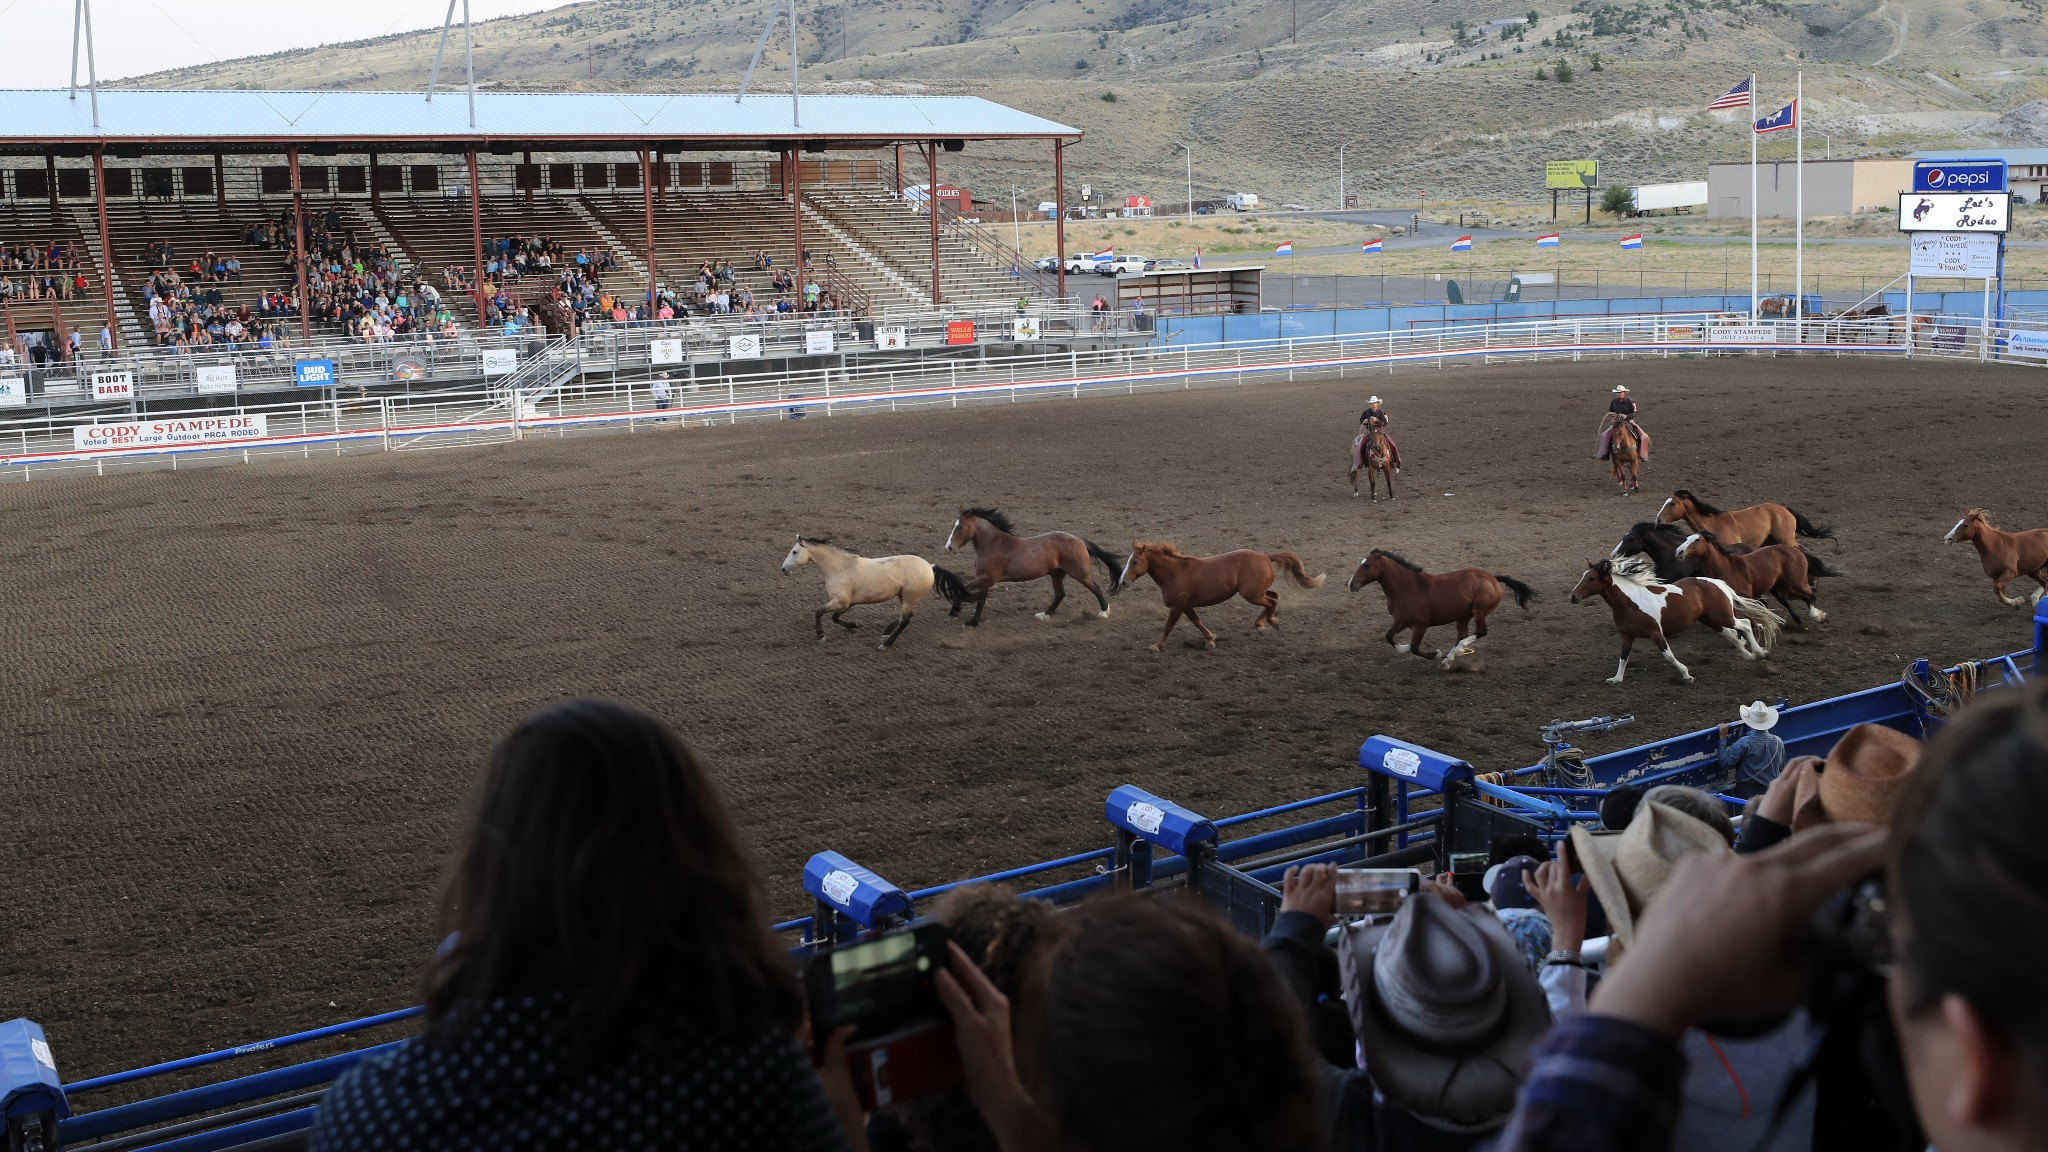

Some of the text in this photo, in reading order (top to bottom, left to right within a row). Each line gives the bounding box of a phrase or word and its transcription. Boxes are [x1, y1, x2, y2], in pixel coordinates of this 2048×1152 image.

[1948, 171, 1989, 186] pepsi
[1959, 197, 1994, 212] Let's
[1956, 215, 1997, 227] Rodeo
[1939, 263, 1967, 271] WYOMING
[304, 366, 326, 374] BUD
[98, 375, 126, 384] BOOT
[300, 373, 330, 382] LIGHT
[98, 385, 128, 394] BARN
[88, 417, 254, 438] CODY STAMPEDE
[83, 438, 107, 446] Voted
[139, 434, 162, 442] Large
[167, 433, 200, 441] Outdoor
